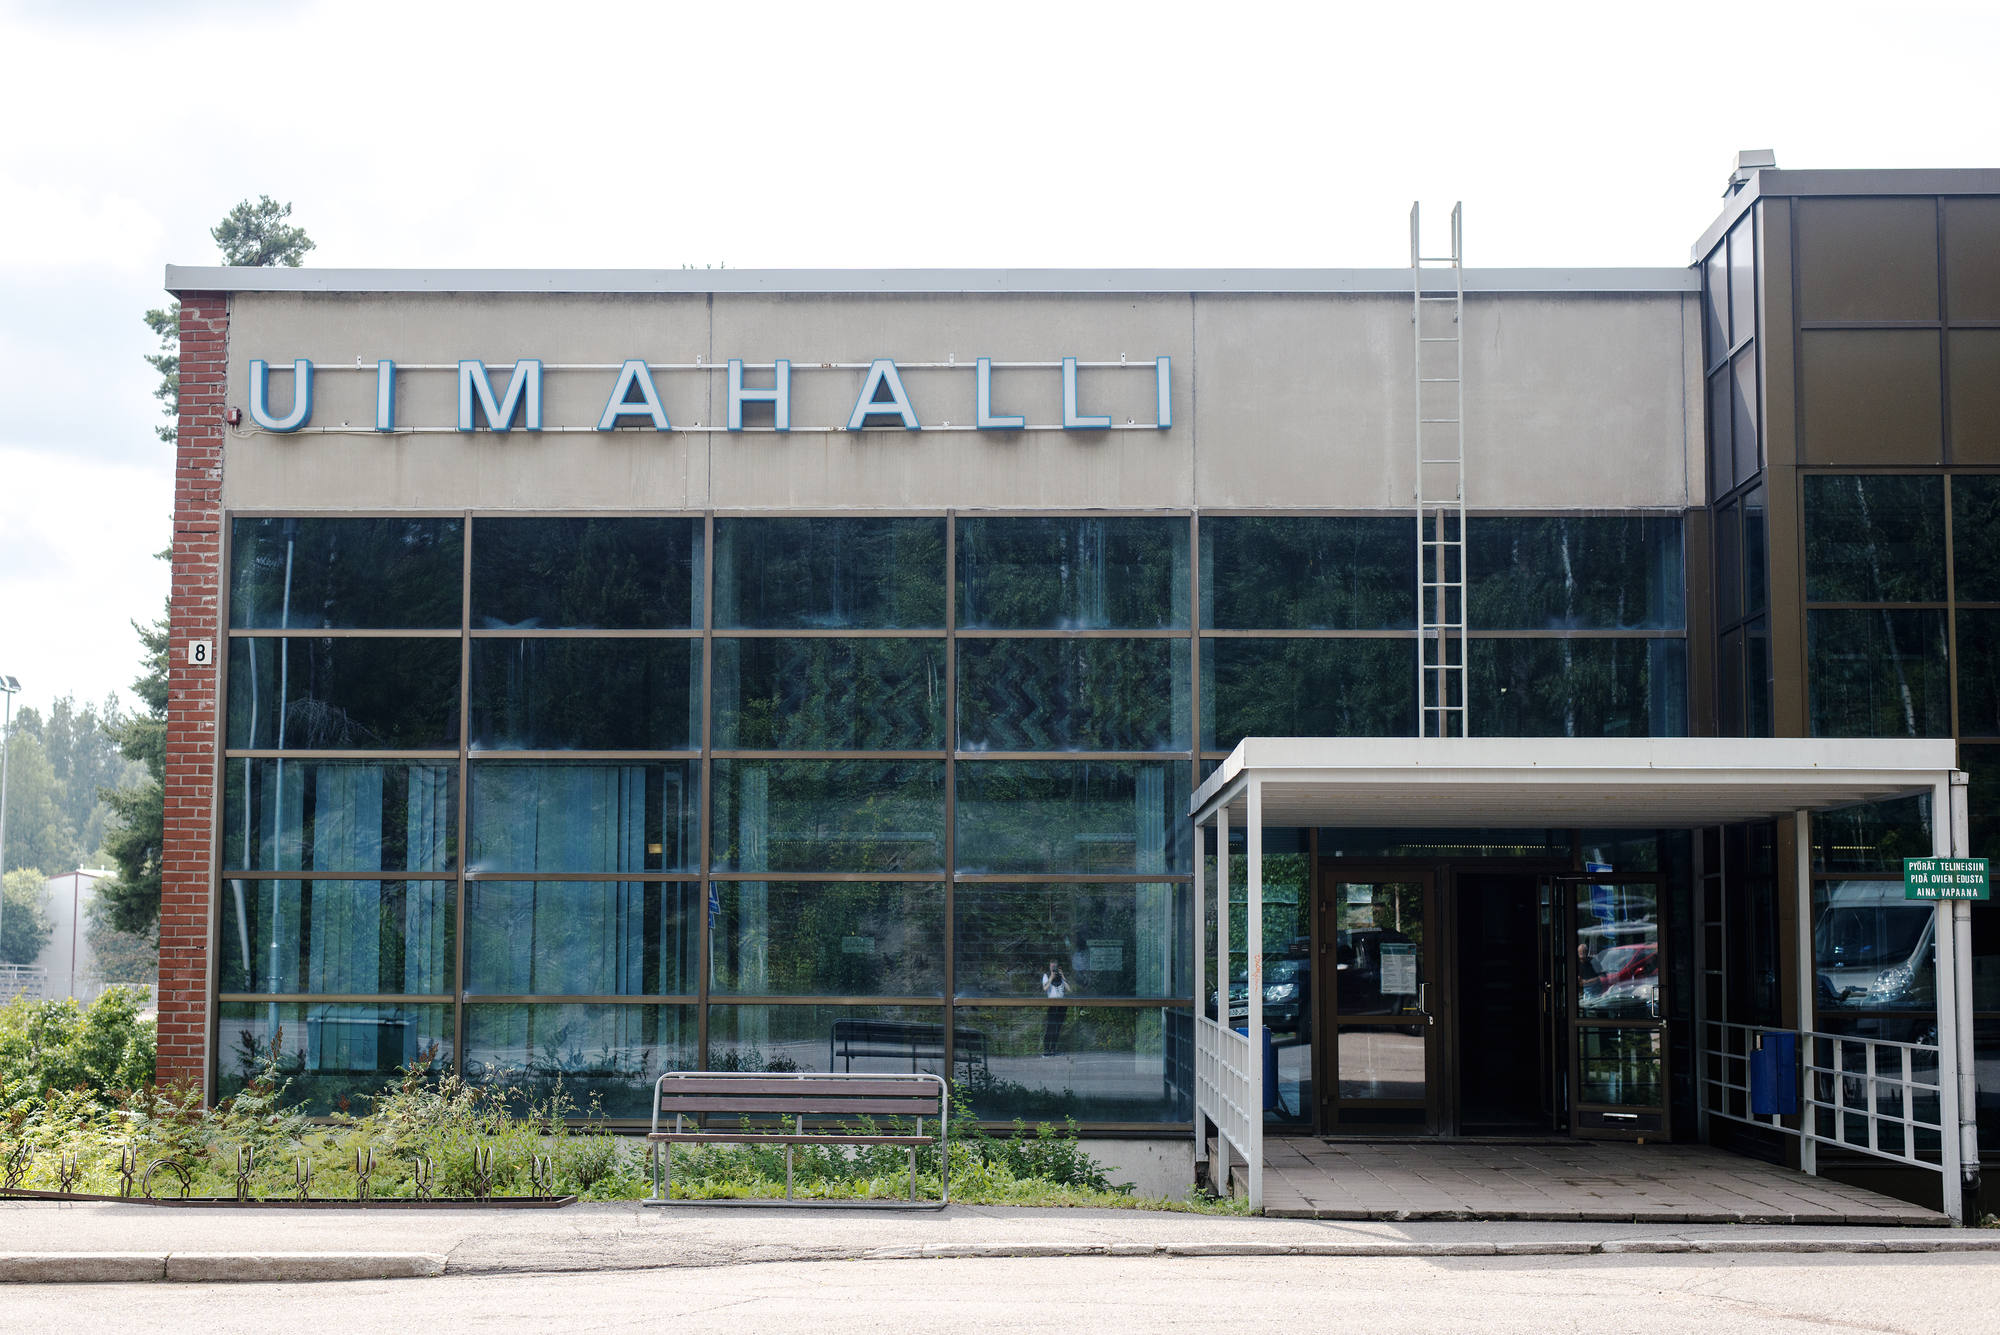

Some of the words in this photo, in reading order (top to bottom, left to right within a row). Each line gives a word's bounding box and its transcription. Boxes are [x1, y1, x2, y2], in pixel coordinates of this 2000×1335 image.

[249, 356, 1172, 432] UIMAHALLI
[195, 644, 205, 661] 8
[1908, 860, 1936, 871] PYÖRÄT
[1940, 862, 1984, 871] TELINEISIIN
[1910, 873, 1928, 883] PIDÄ
[1931, 874, 1953, 883] OVIEN
[1956, 874, 1984, 884] EDUSTA
[1916, 887, 1936, 897] AINA
[1941, 887, 1978, 897] VAPAANA
